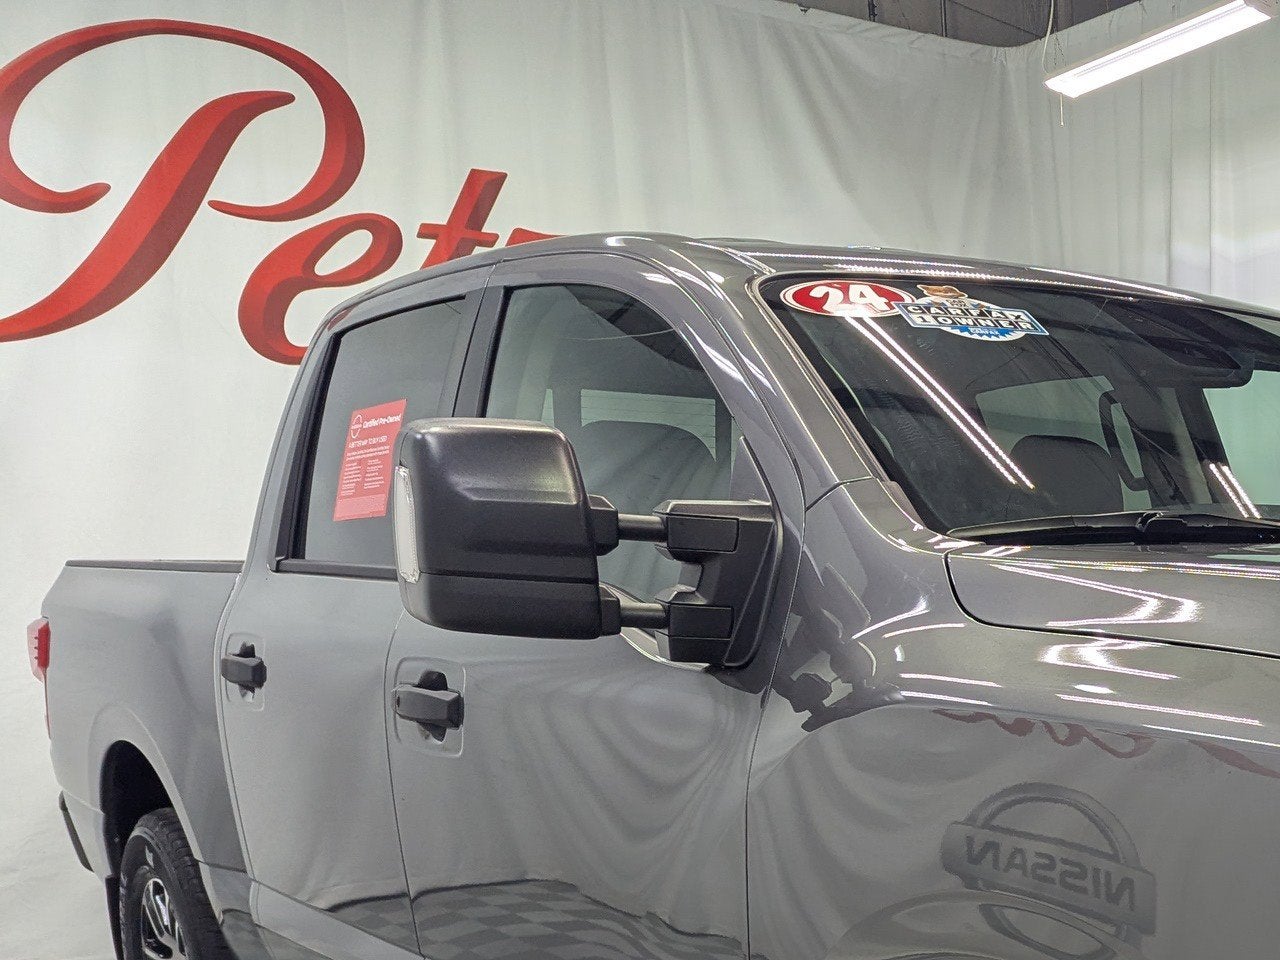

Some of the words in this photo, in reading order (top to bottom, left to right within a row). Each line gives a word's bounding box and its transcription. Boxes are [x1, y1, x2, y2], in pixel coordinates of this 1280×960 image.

[0, 19, 565, 365] Pet
[809, 284, 892, 313] 24
[906, 305, 1025, 321] CARFAX
[937, 316, 1035, 330] OWNER
